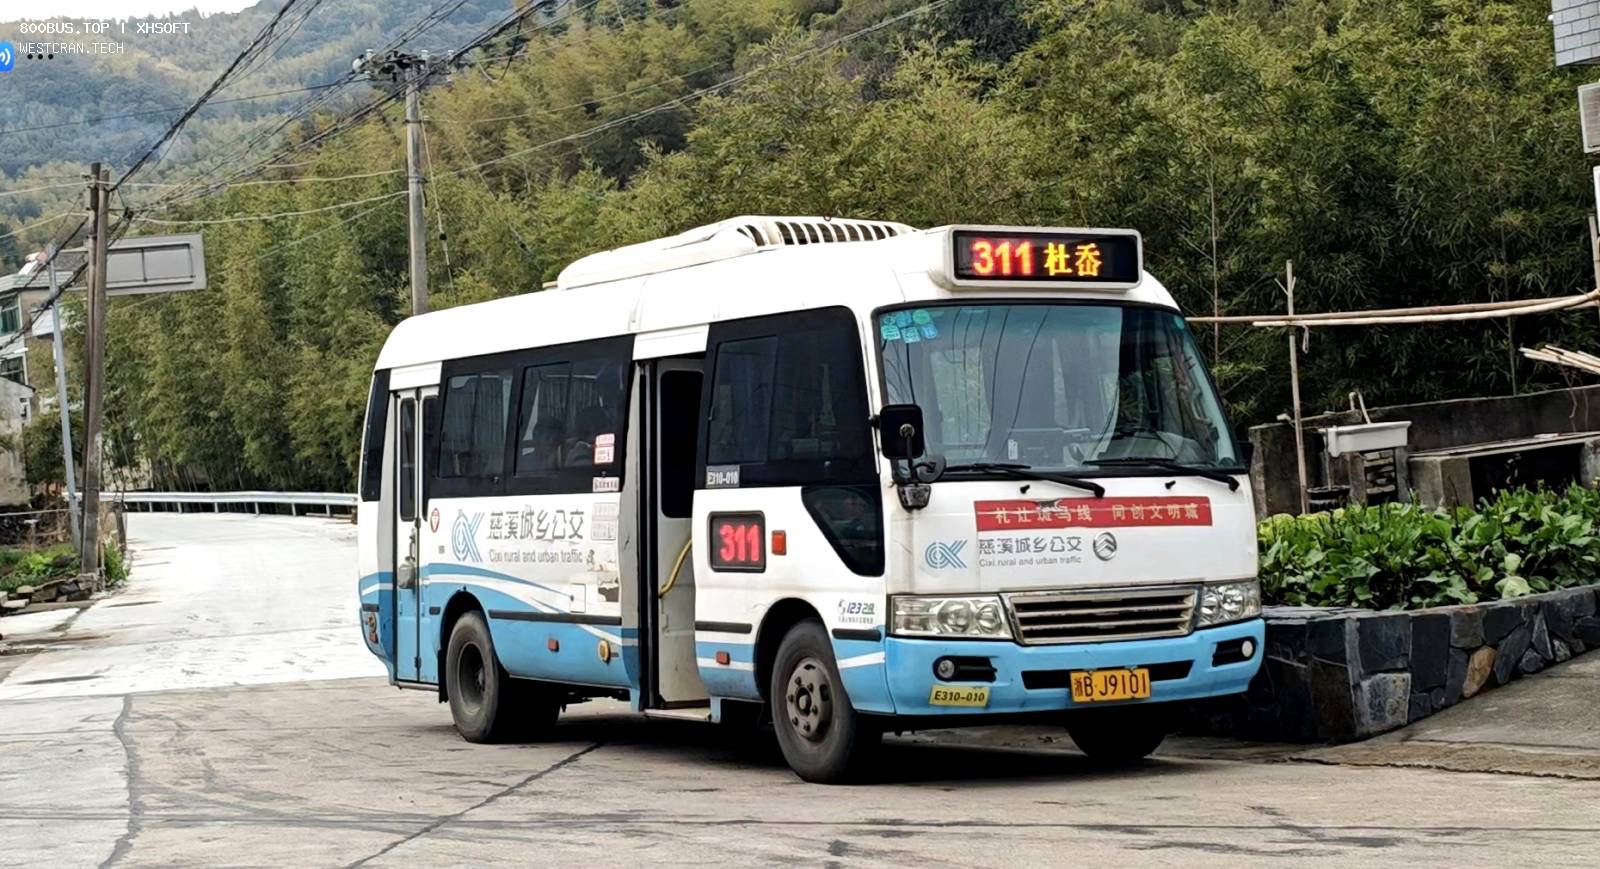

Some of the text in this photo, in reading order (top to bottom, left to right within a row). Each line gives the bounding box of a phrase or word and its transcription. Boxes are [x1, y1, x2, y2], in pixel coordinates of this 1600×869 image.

[971, 240, 1103, 277] 311 杜岙
[487, 509, 585, 541] 慈溪城乡公交
[720, 523, 761, 562] 311
[979, 536, 1083, 556] 慈溪城乡公交
[523, 549, 536, 562] and
[1018, 556, 1034, 566] and
[1036, 556, 1057, 565] urban
[934, 690, 986, 702] E310-010
